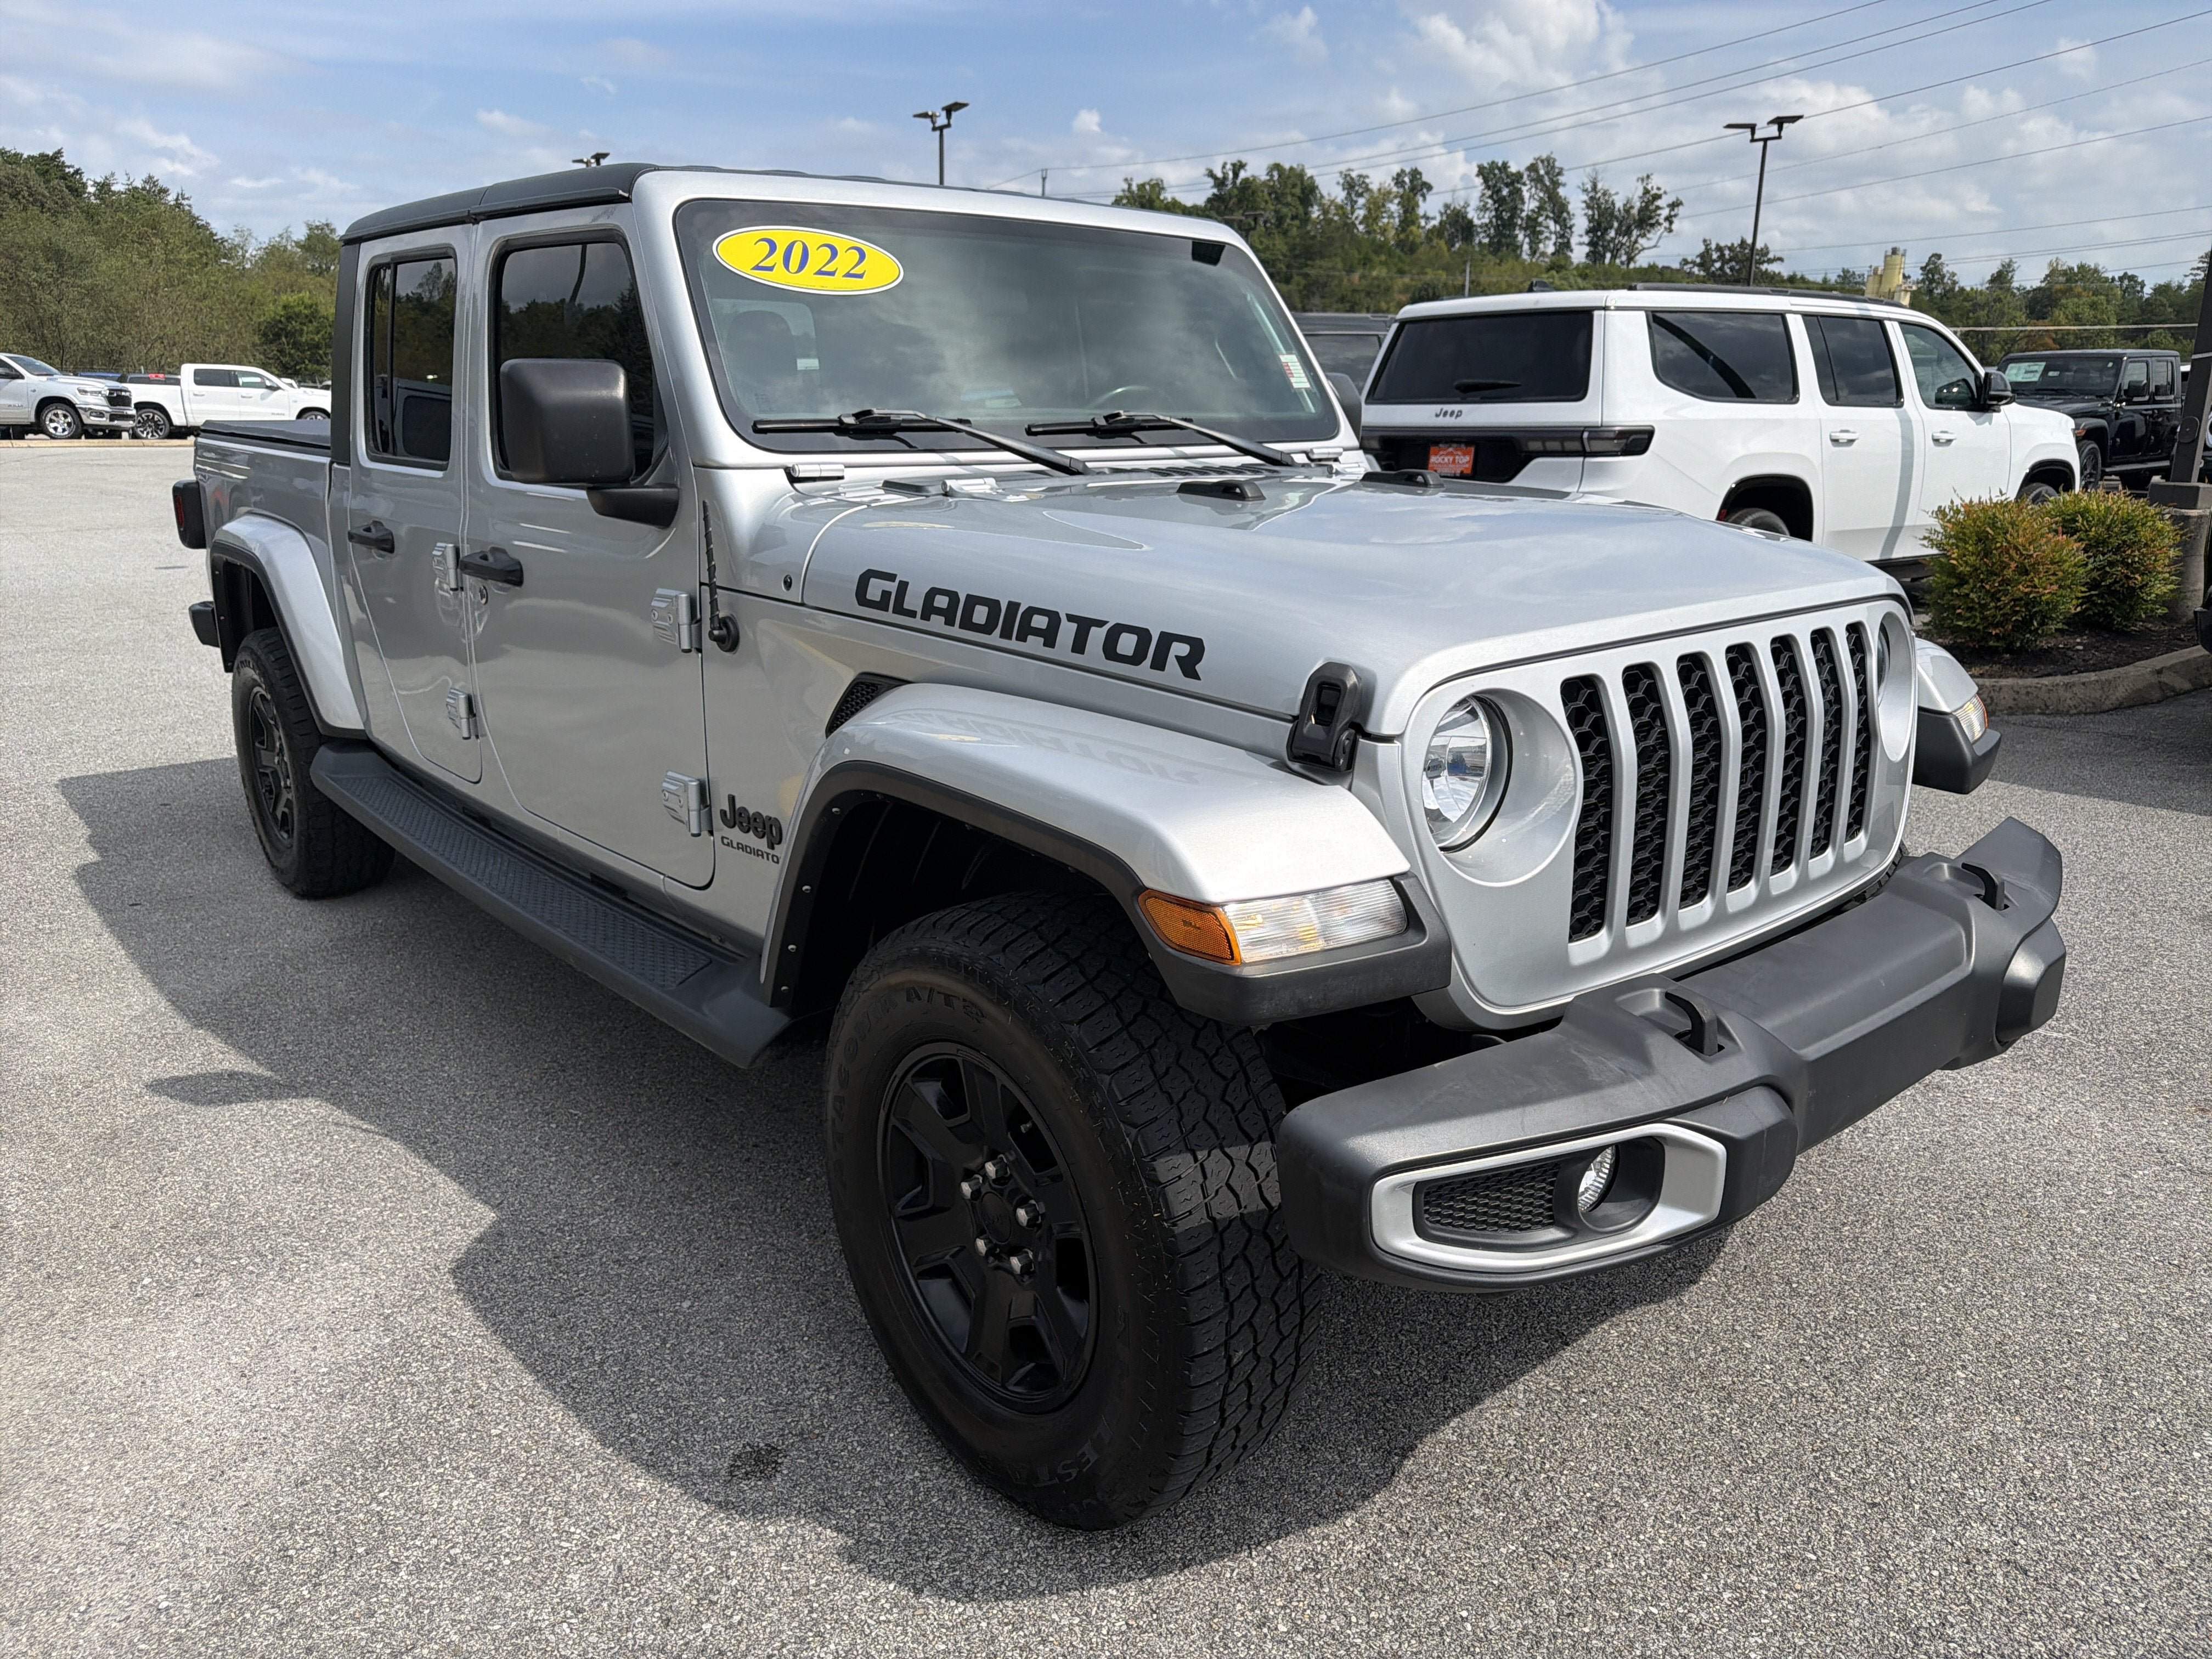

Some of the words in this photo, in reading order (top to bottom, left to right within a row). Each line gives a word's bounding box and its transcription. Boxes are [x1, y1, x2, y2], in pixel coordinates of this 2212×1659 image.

[751, 238, 867, 279] 2022
[1435, 408, 1463, 419] Jeep
[855, 568, 1205, 681] GLADIATOR
[719, 794, 783, 850] Jeep
[720, 836, 780, 865] GLADIATO
